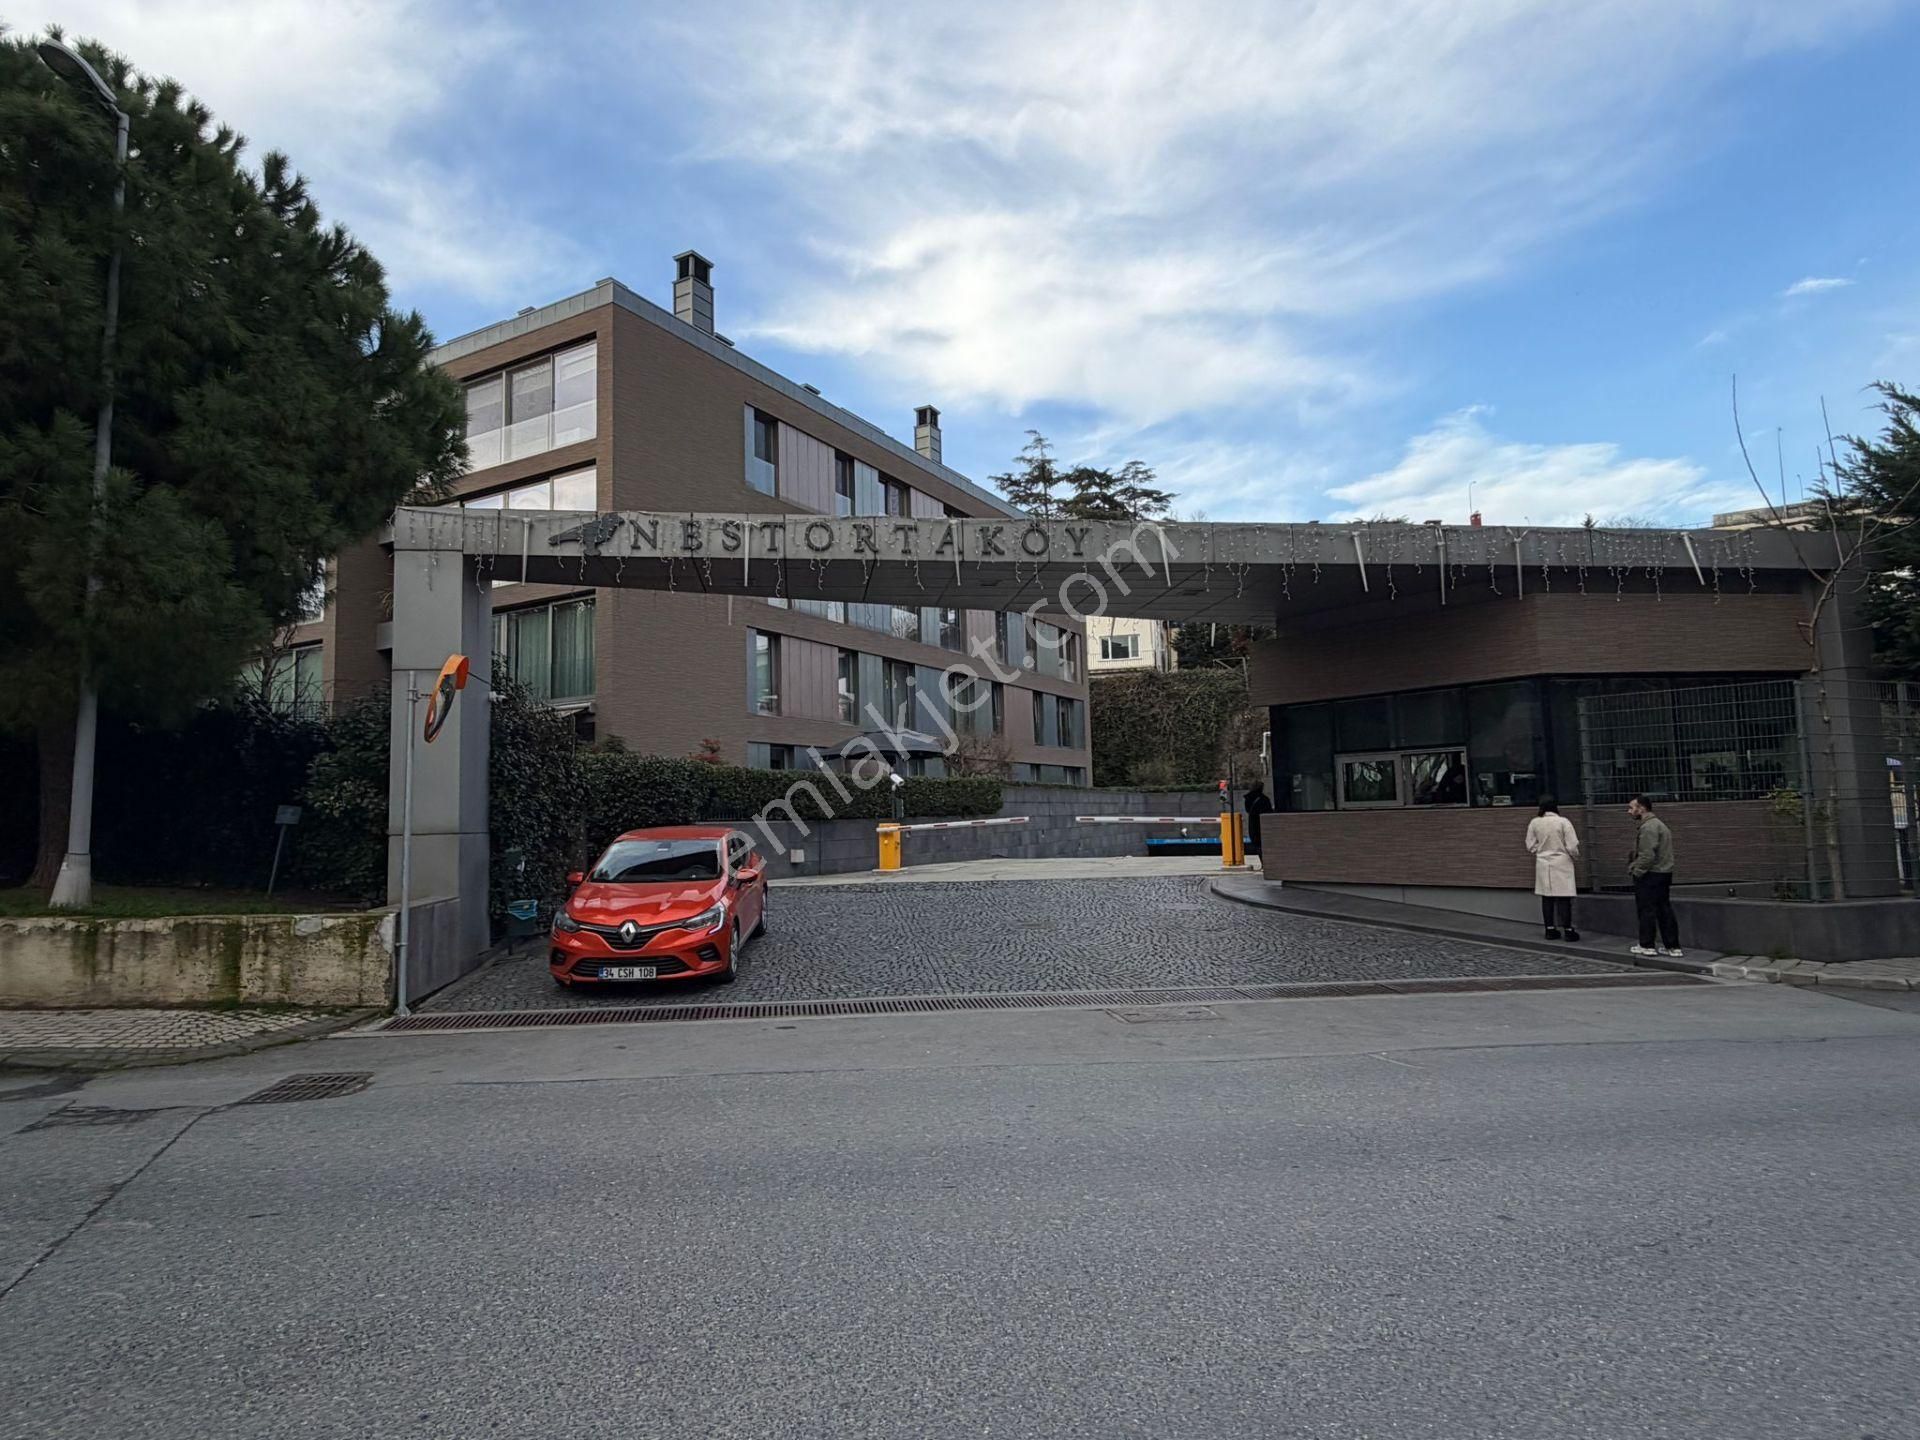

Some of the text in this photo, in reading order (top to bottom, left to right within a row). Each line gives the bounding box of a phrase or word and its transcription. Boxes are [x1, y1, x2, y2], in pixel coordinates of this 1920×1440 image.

[629, 518, 1091, 557] NESTORTAKÖY
[604, 968, 614, 978] 34
[618, 968, 634, 978] CSH
